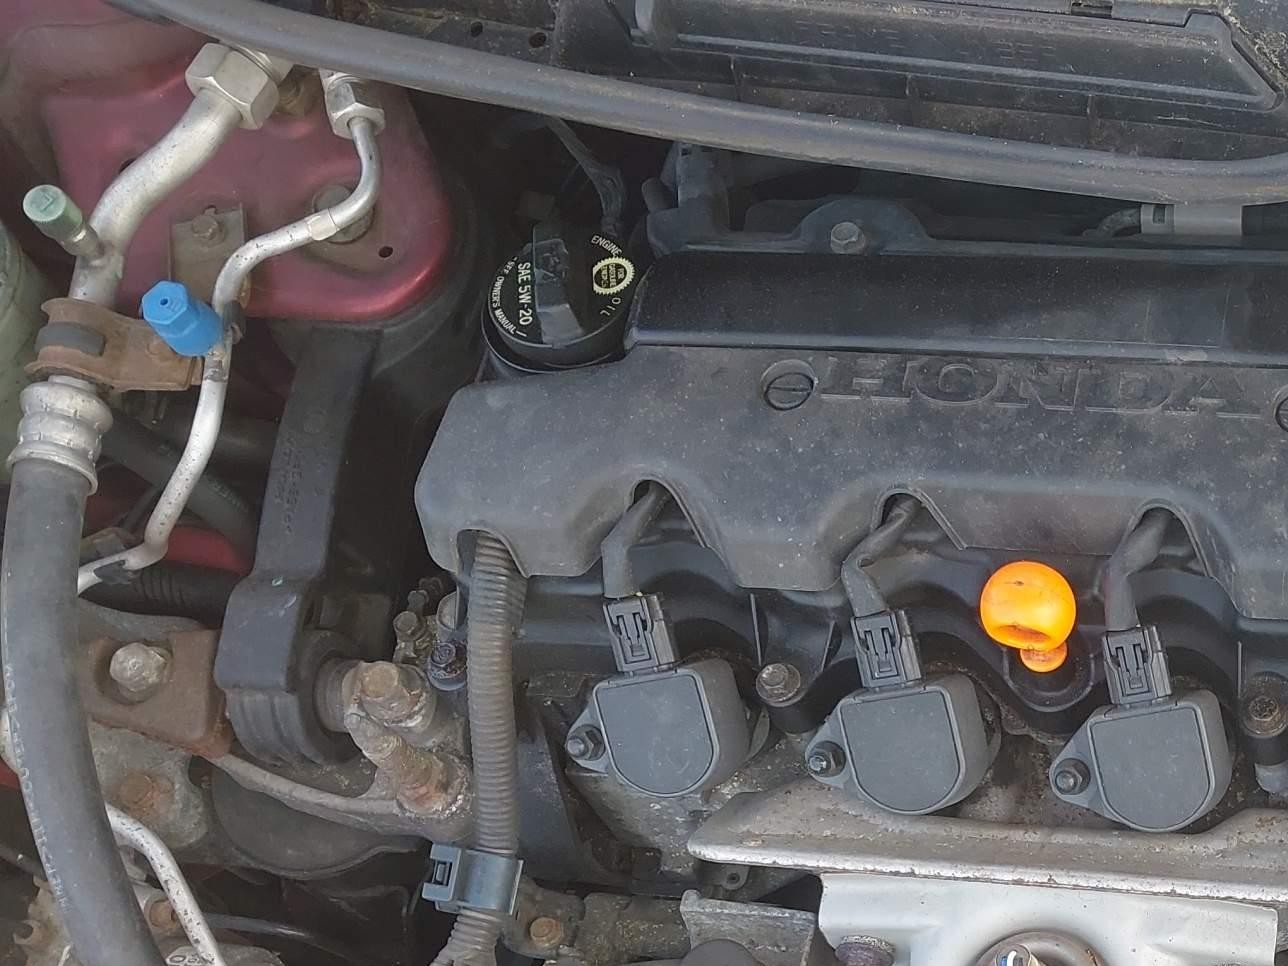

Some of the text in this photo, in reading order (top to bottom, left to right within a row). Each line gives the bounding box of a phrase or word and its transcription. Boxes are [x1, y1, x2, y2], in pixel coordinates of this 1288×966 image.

[517, 261, 533, 326] SAE 5W-20
[591, 234, 622, 317] ENGINE OIL
[494, 308, 517, 335] MANUAL
[820, 355, 1262, 419] HONDA
